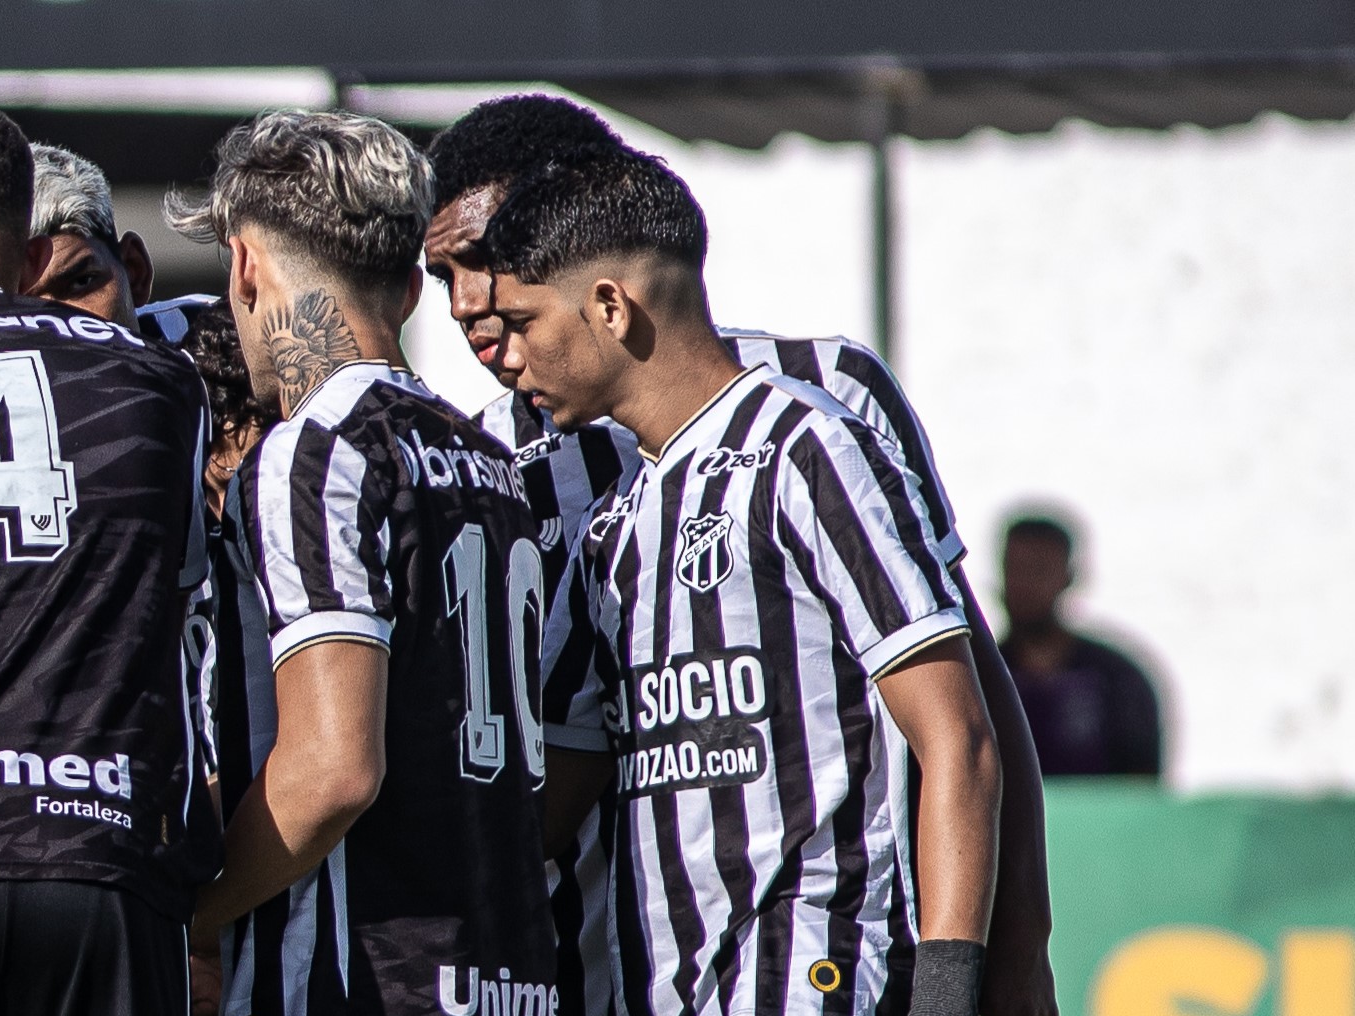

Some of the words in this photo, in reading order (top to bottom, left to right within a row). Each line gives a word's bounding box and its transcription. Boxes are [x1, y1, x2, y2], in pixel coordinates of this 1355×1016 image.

[442, 522, 545, 791] 10
[638, 655, 766, 731] SÓCIO
[36, 796, 132, 829] Fortaleza
